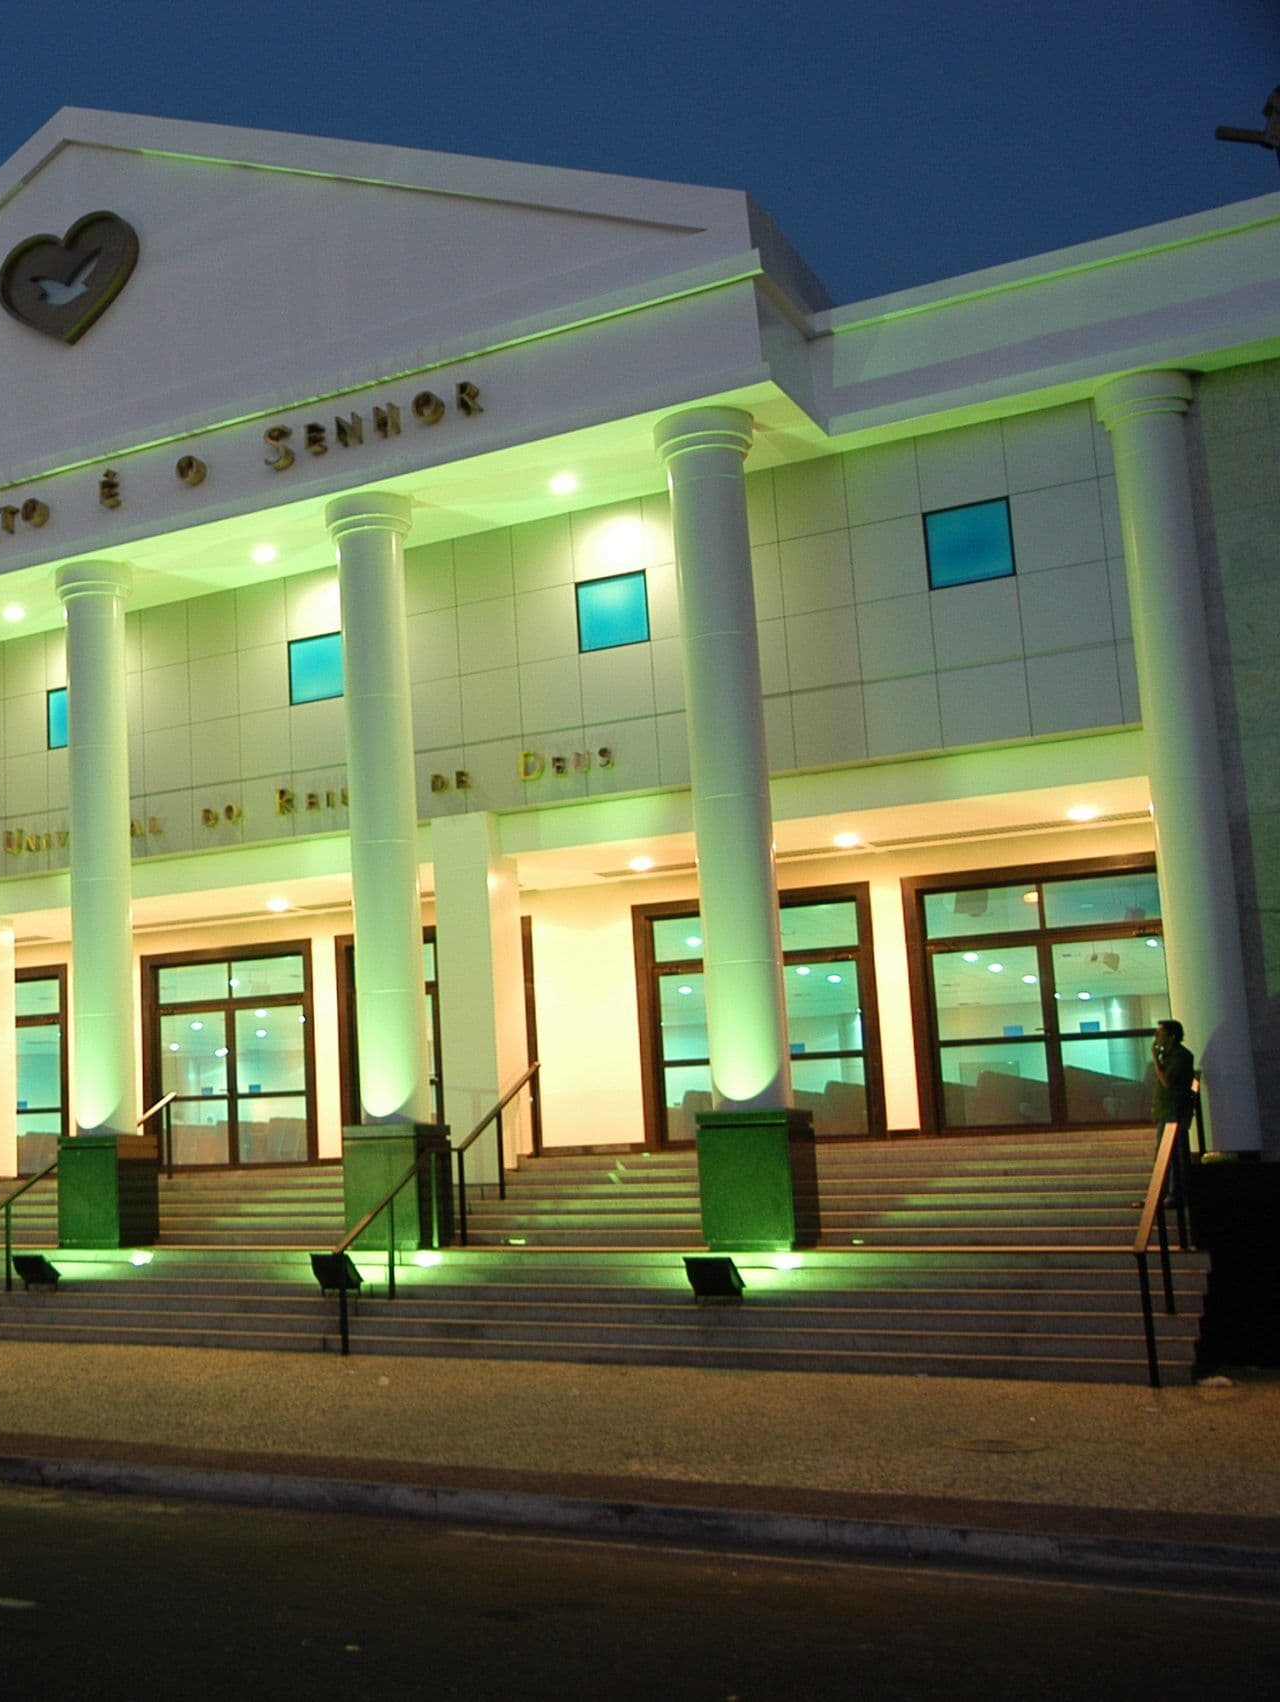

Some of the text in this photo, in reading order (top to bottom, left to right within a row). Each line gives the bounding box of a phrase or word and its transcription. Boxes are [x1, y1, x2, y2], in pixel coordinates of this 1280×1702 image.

[175, 455, 208, 487] O
[263, 381, 484, 472] SENHOR
[3, 815, 163, 857] UNIVAL
[201, 802, 242, 828] DO
[431, 770, 472, 793] DE
[520, 747, 615, 782] DEUS
